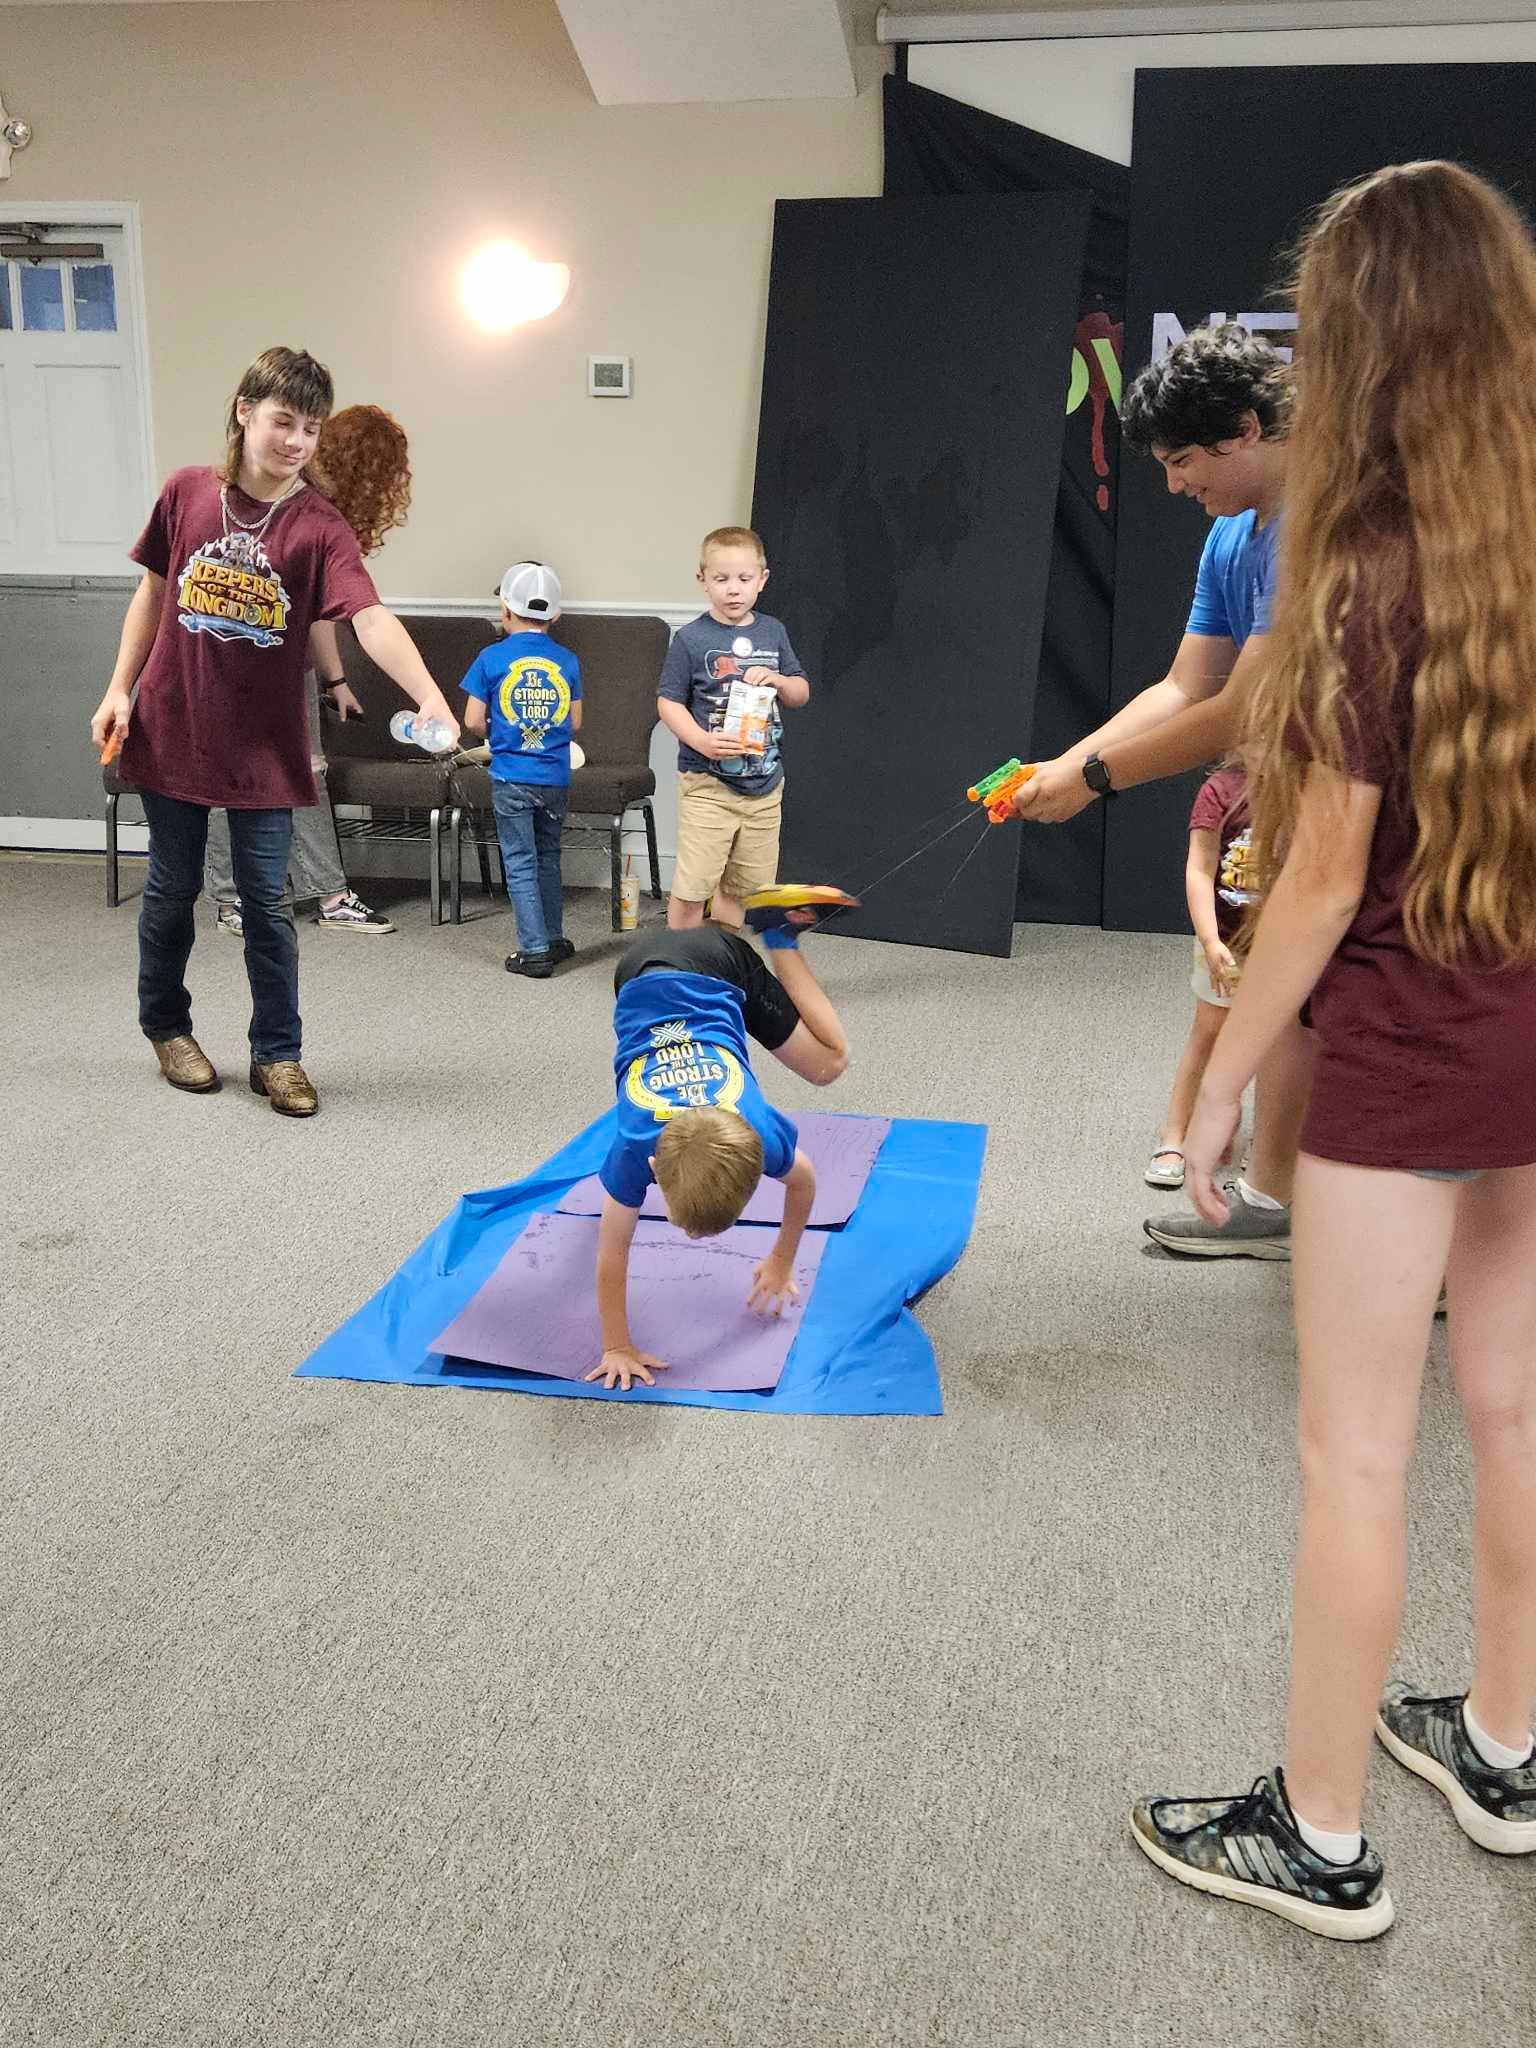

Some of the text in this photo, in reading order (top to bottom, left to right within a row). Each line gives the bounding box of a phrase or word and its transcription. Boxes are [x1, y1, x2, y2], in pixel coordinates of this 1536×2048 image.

[190, 559, 278, 602] KEEPERS
[206, 582, 256, 603] OF THE
[180, 578, 286, 629] KINGDOM
[514, 687, 557, 701] STRONG
[522, 705, 549, 719] LORD
[655, 1041, 705, 1065] LORD
[649, 1063, 724, 1091] STRONG
